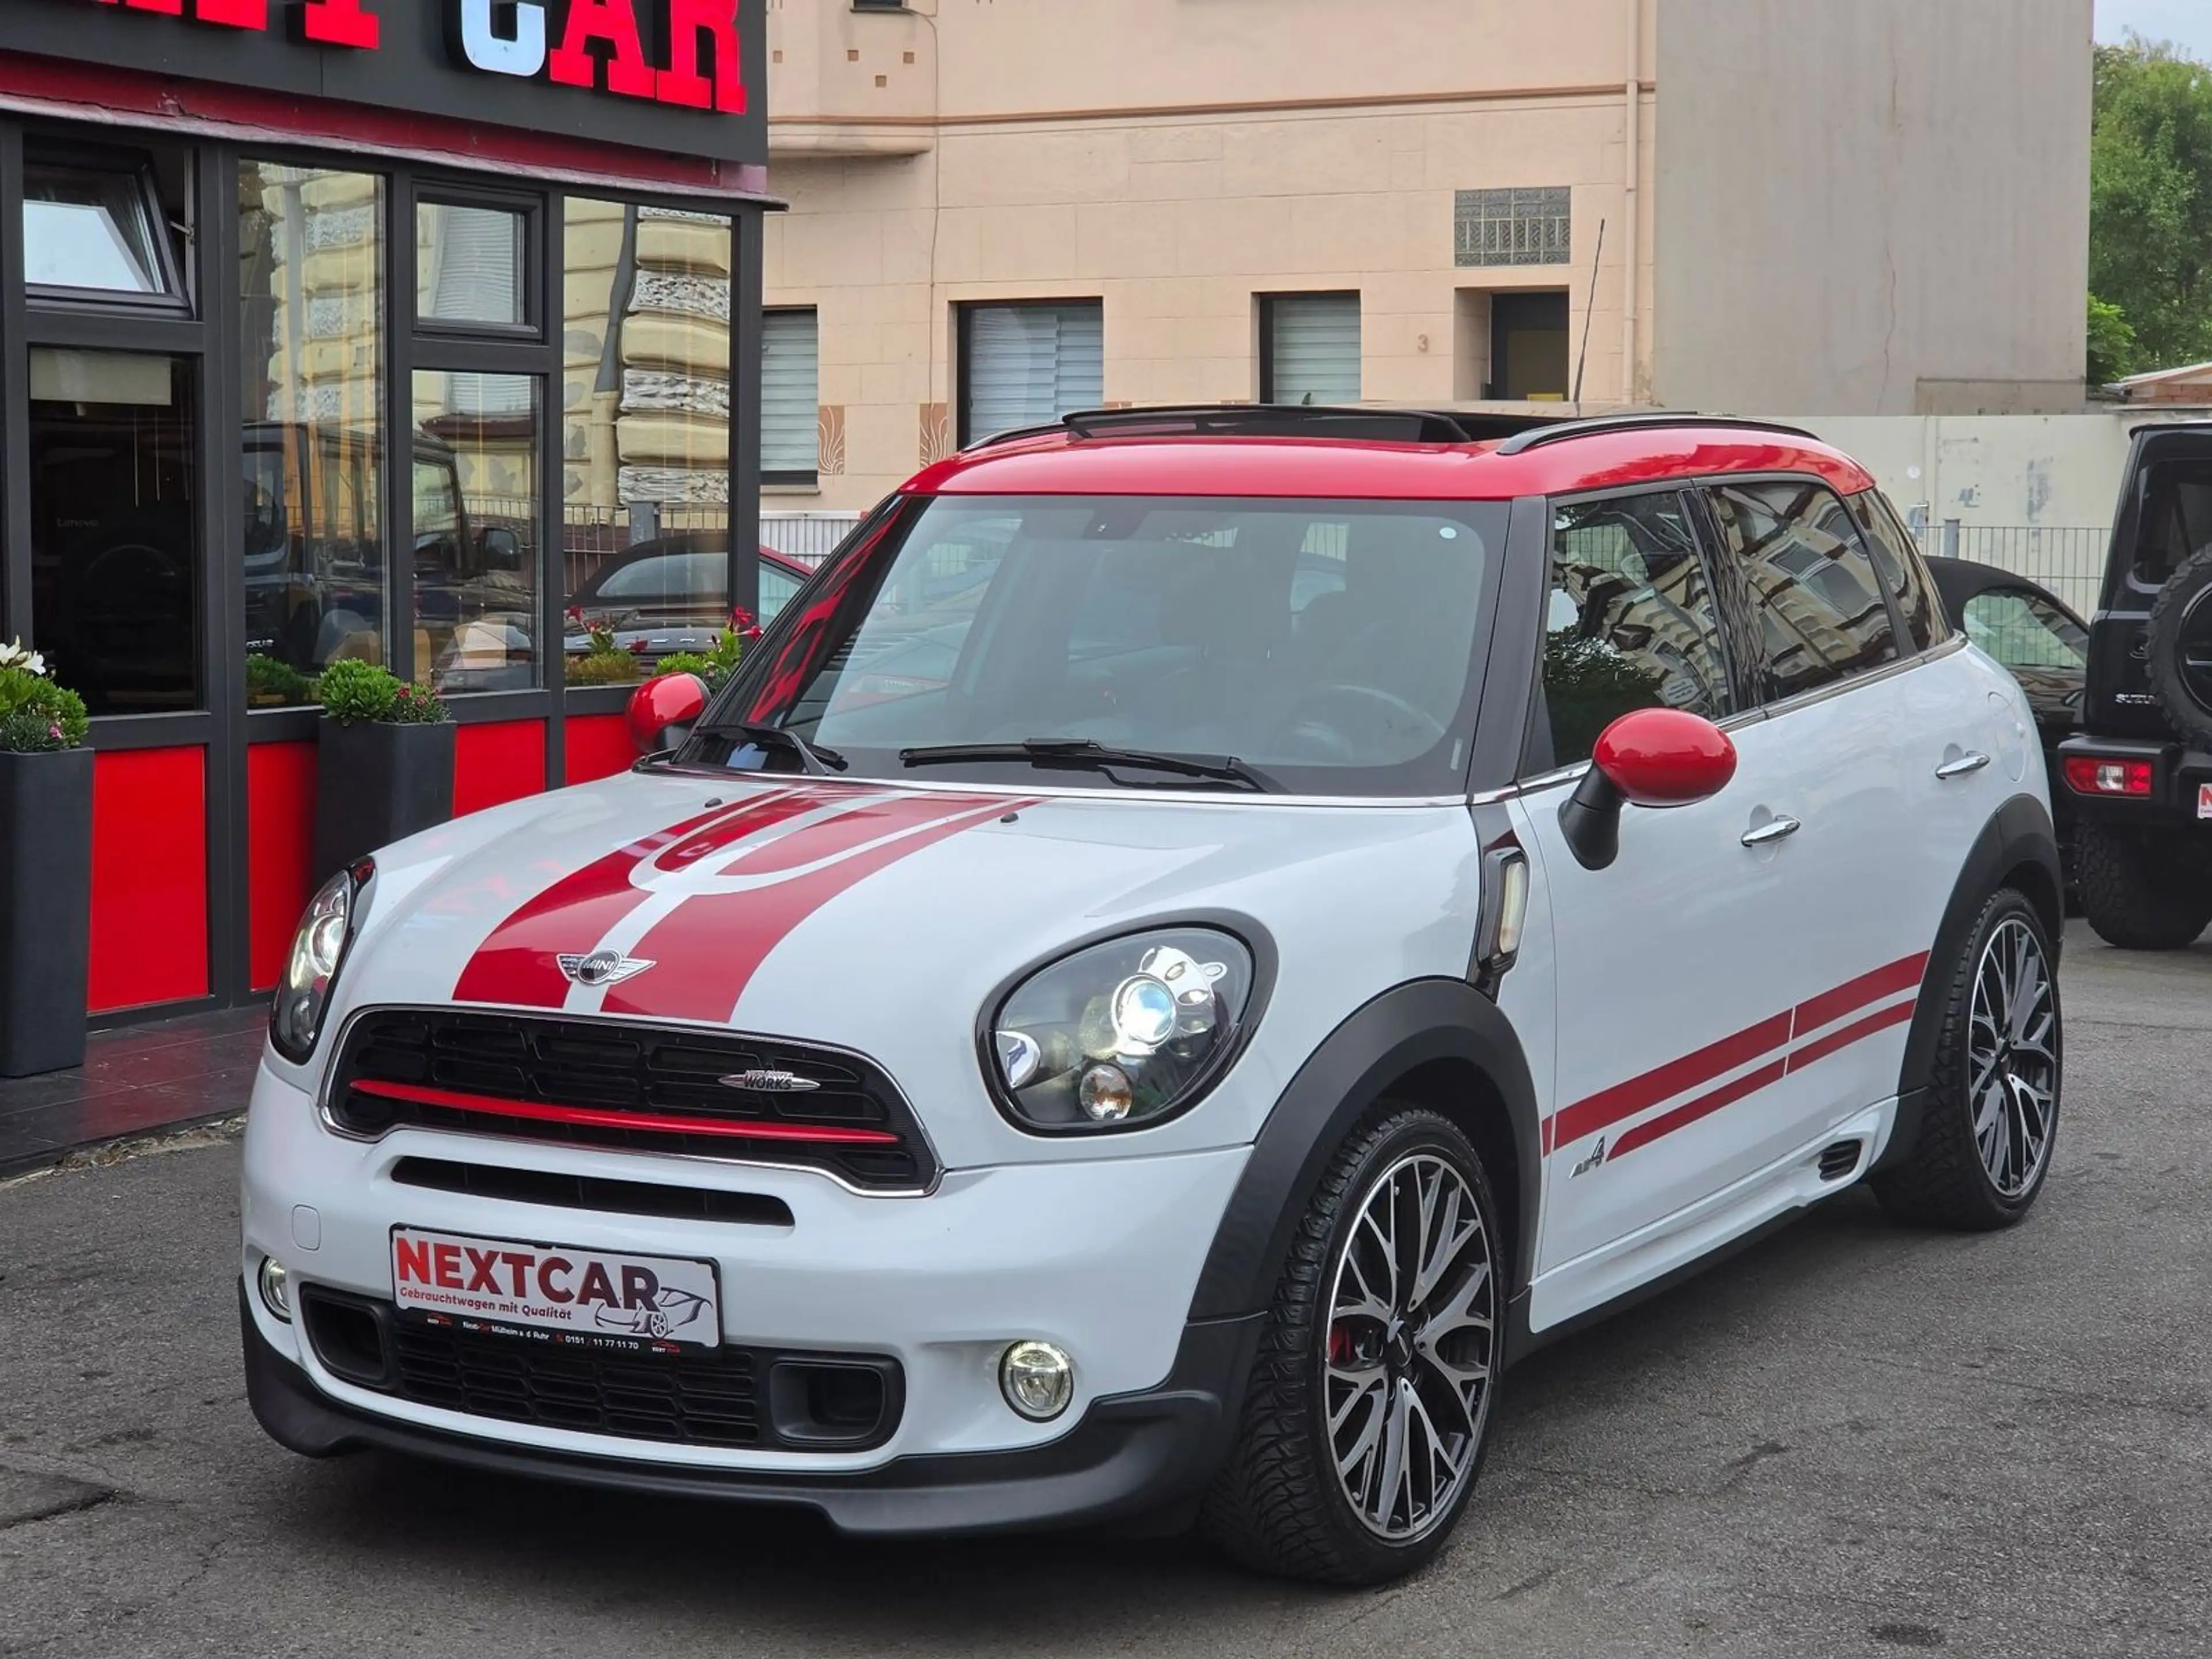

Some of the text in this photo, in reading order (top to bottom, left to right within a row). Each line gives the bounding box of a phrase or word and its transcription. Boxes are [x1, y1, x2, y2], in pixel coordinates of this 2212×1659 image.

[1417, 334, 1429, 353] 3
[584, 959, 615, 971] MINI
[744, 1077, 793, 1090] WORKS
[396, 1237, 660, 1312] NEXTCAR
[400, 1287, 572, 1320] Gebrauchtwagen mit Qualität
